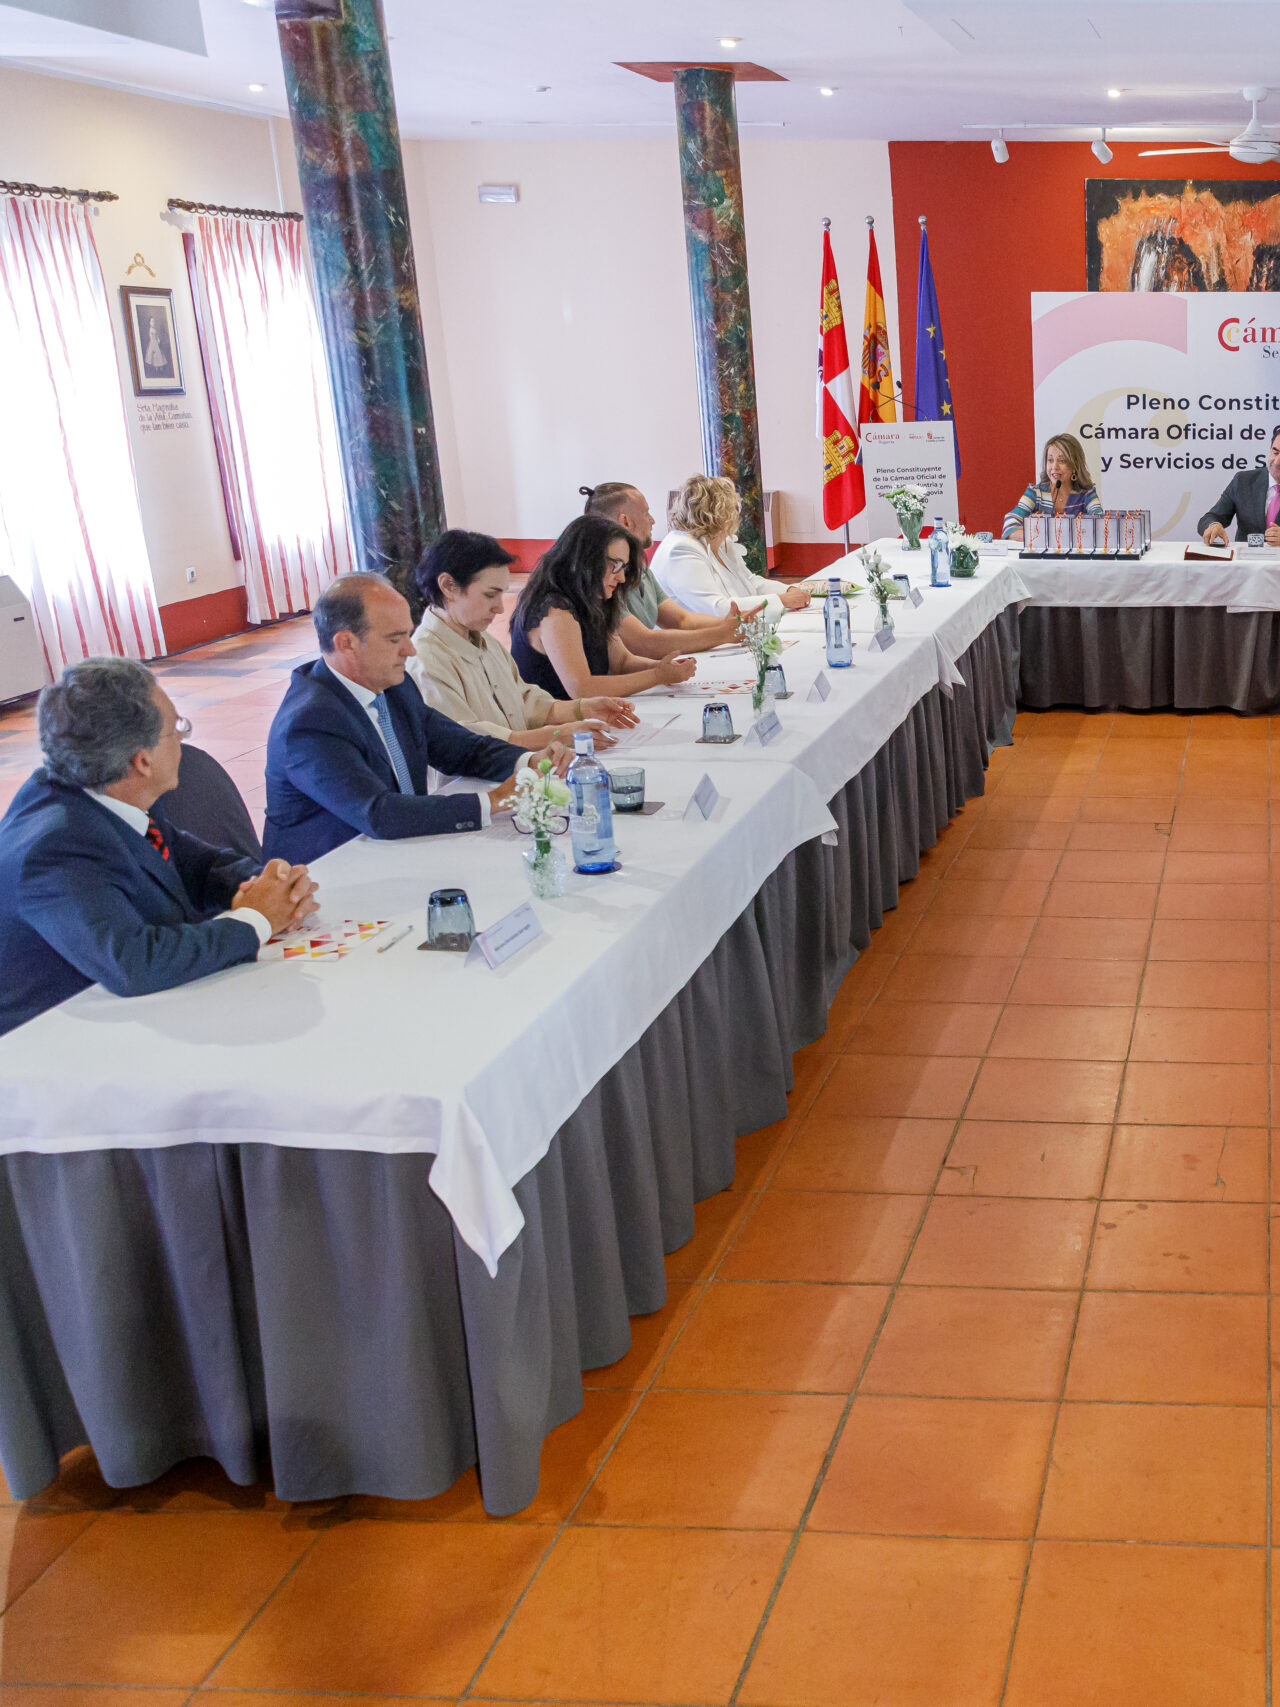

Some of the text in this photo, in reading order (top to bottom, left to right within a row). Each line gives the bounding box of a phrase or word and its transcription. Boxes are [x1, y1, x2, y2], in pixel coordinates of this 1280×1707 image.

[1126, 394, 1190, 411] Pleno
[865, 432, 900, 443] Cámara
[1079, 423, 1160, 440] Cámara
[1166, 423, 1233, 440] Oficial
[1240, 424, 1266, 440] de
[1100, 456, 1113, 472] y
[1119, 452, 1215, 470] Servicios
[1221, 454, 1248, 470] de
[890, 474, 915, 482] Cámara
